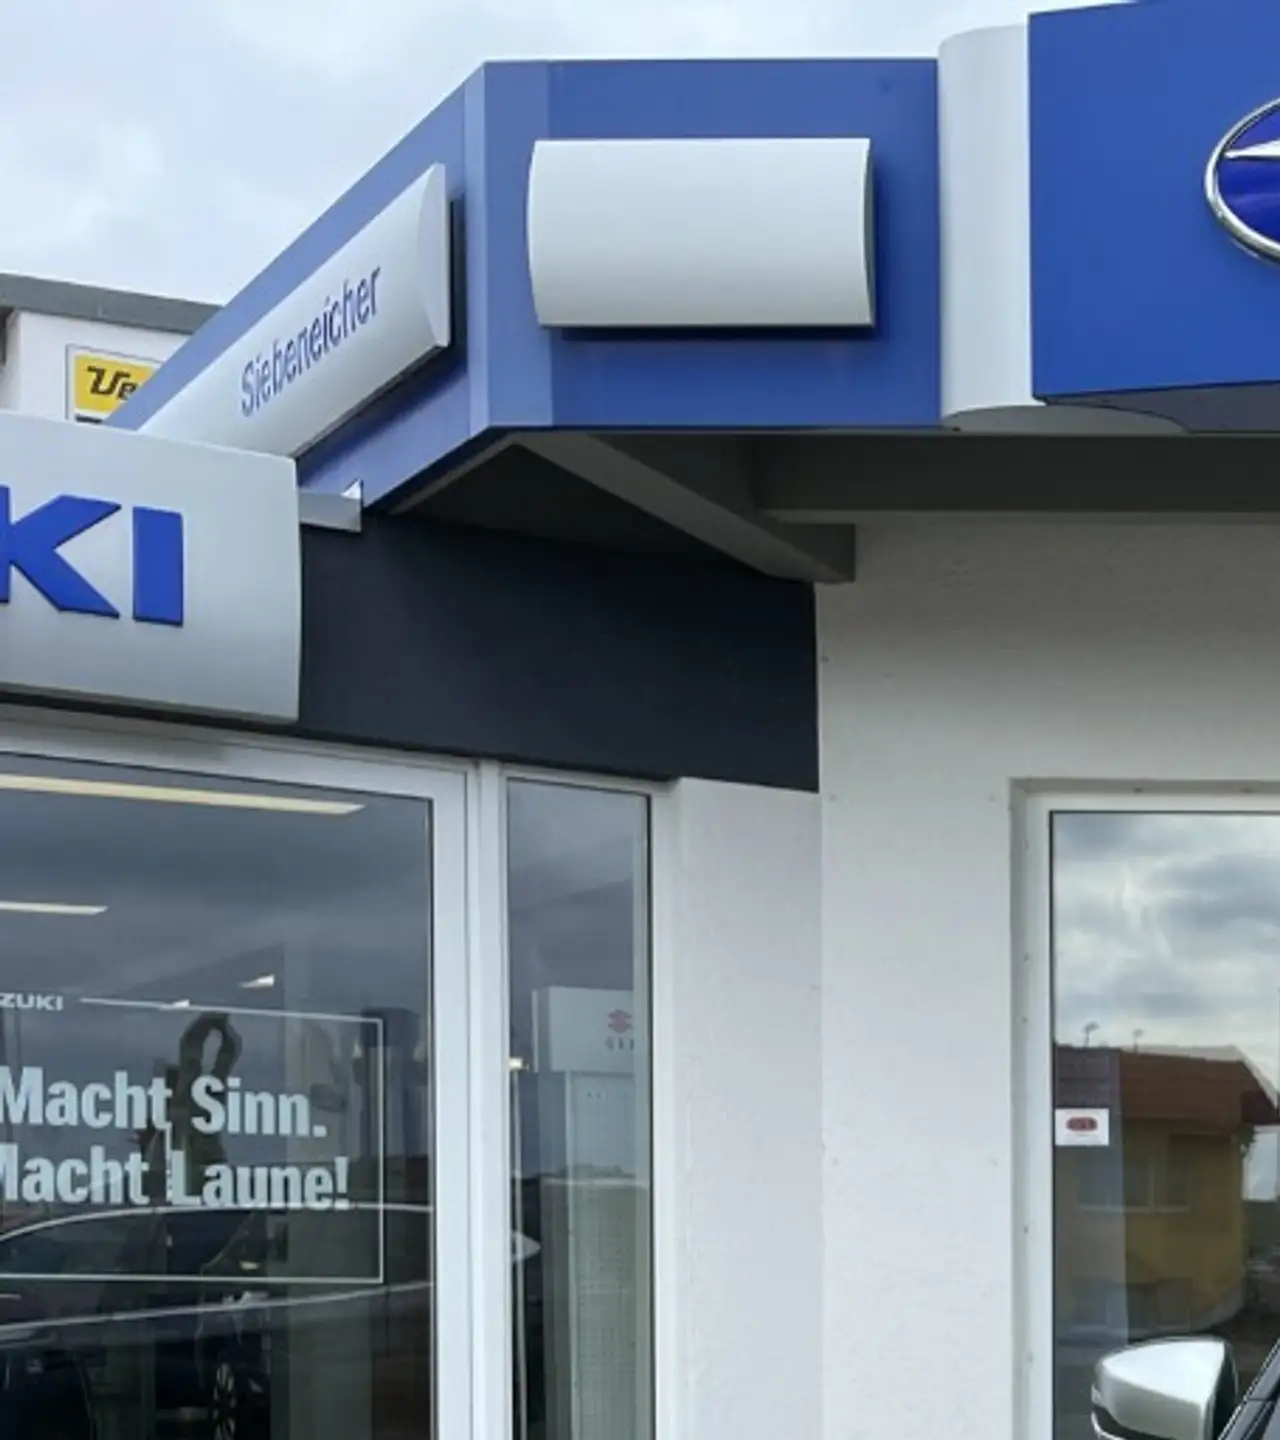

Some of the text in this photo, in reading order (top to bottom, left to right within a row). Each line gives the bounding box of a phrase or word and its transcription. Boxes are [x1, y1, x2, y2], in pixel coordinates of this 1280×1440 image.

[240, 266, 381, 418] Siebeneicher
[0, 1065, 328, 1138] Macht Sinn.
[167, 1150, 350, 1211] Laune!
